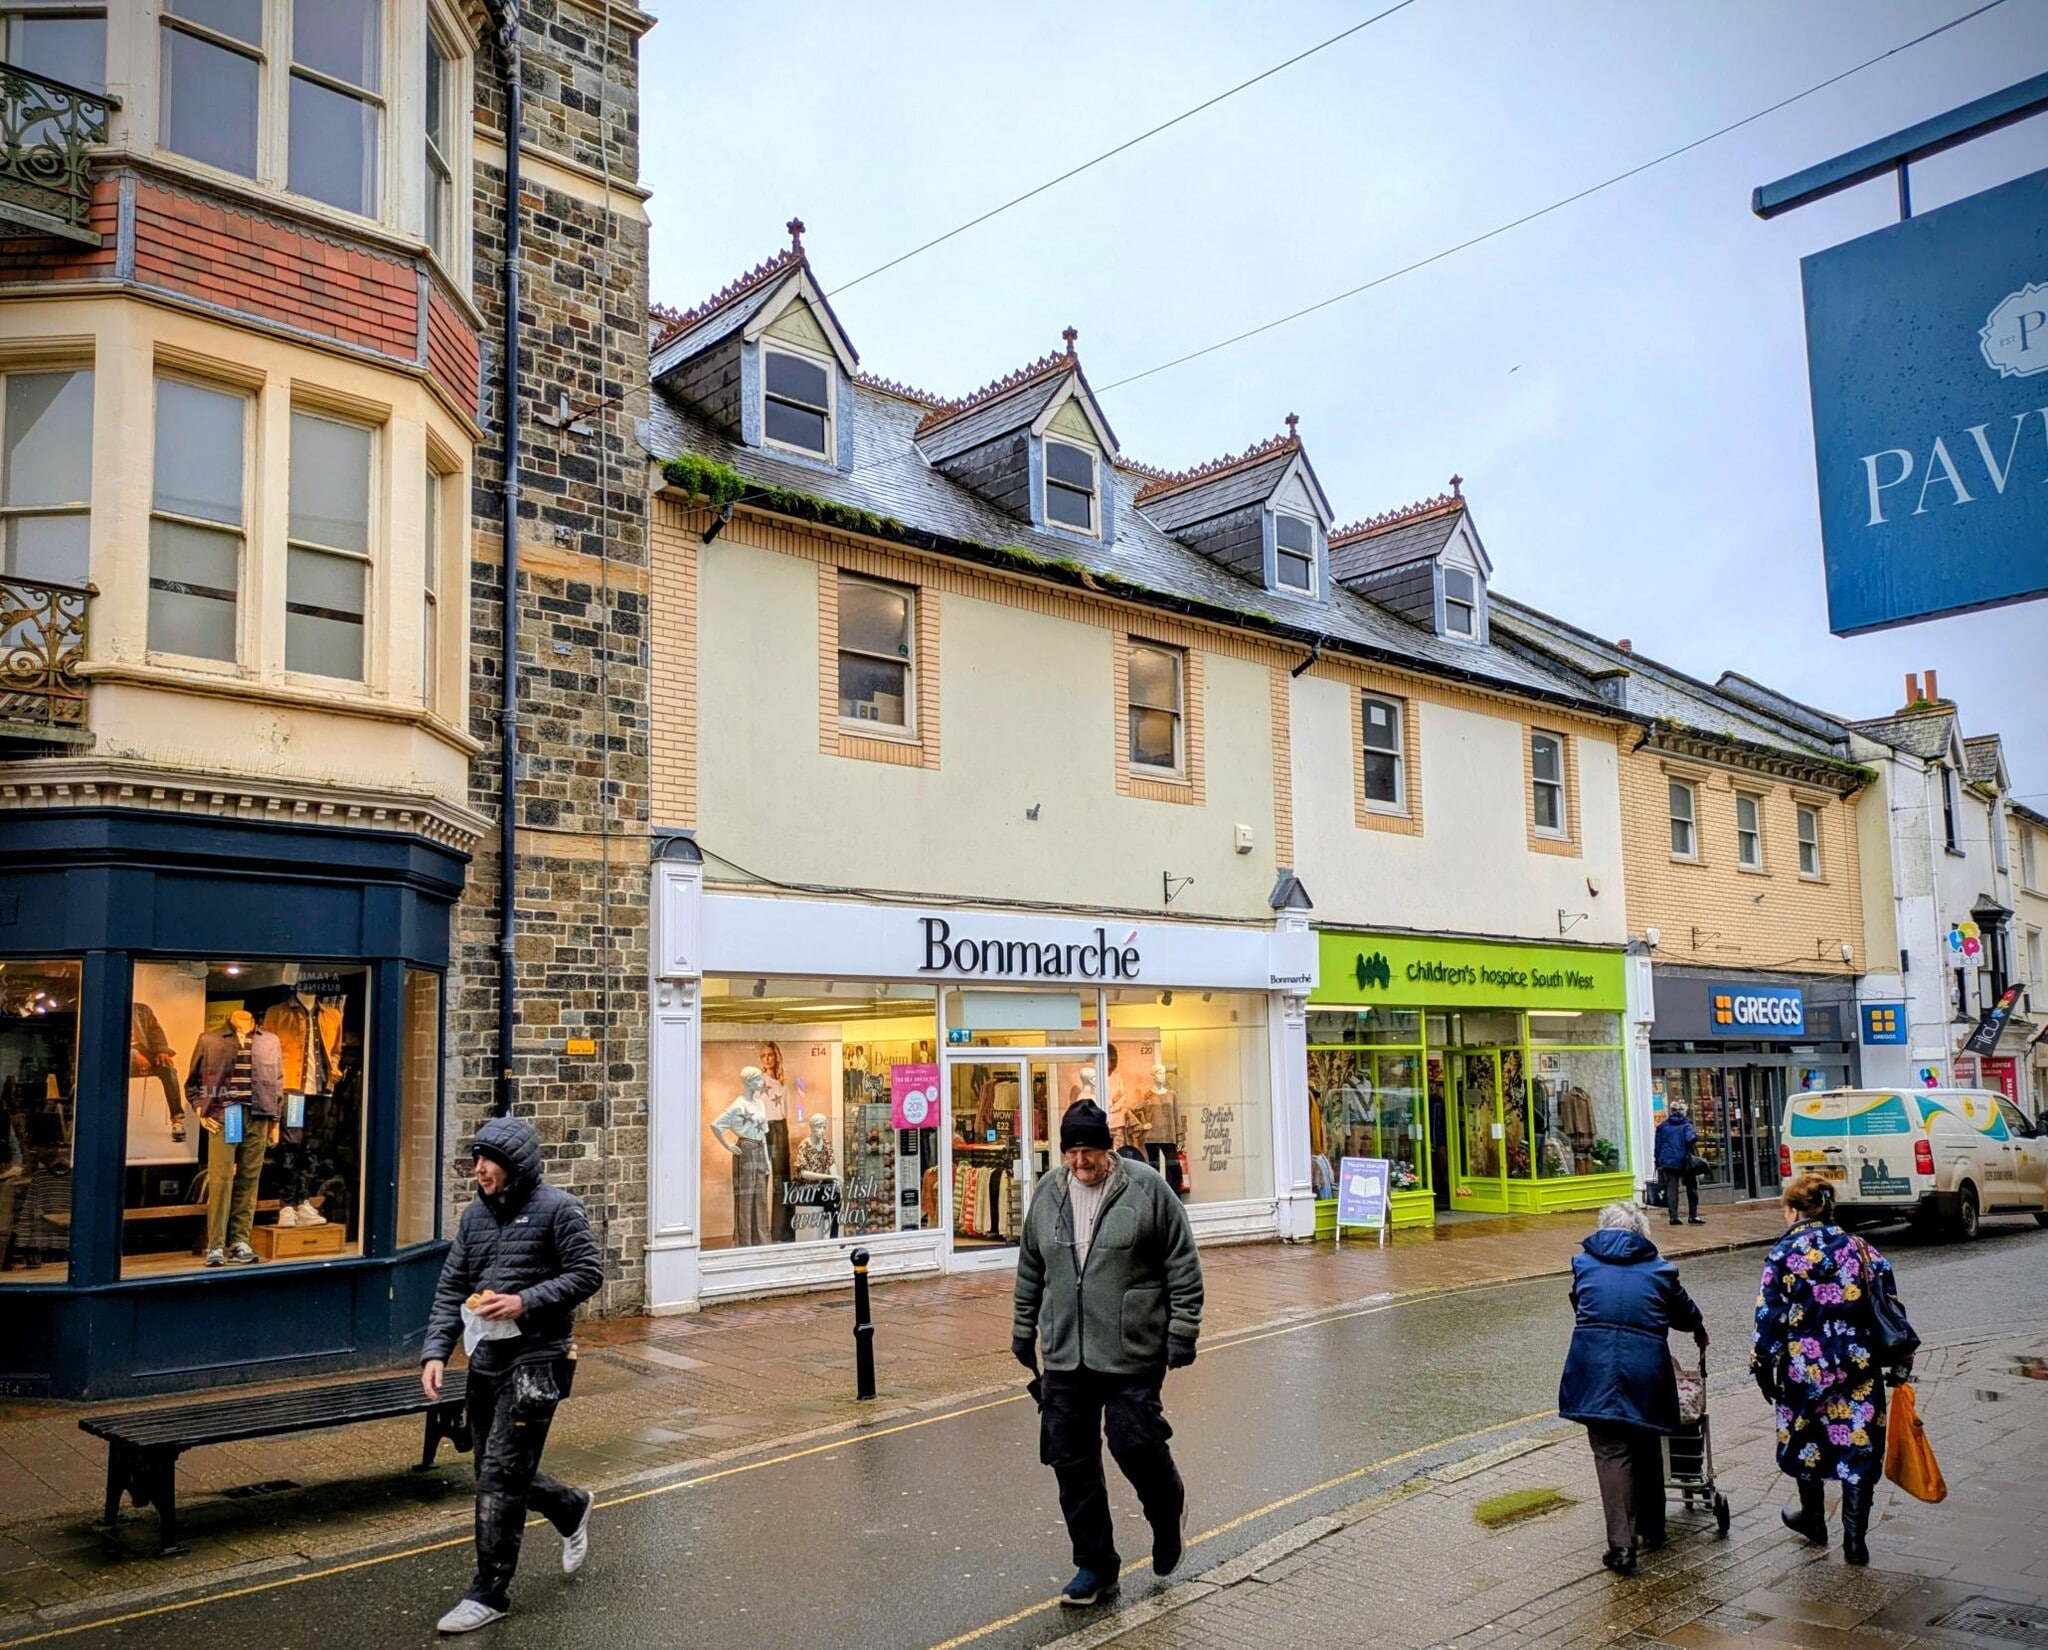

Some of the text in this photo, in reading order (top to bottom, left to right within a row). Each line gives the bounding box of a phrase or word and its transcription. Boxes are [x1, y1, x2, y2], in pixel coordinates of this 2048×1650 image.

[2016, 310, 2046, 352] P
[918, 917, 1140, 978] Bonmarché
[1270, 973, 1312, 984] Bonmarché
[1481, 964, 1528, 989] hospice
[1531, 968, 1564, 988] South
[1565, 969, 1595, 989] West
[1734, 995, 1801, 1025] GREGGS
[811, 1047, 826, 1057] £14
[874, 1050, 908, 1067] Denim
[1140, 1046, 1152, 1055] £20
[997, 1122, 1009, 1130] £22
[1201, 1107, 1234, 1128] Stylish
[1204, 1123, 1230, 1139] looks
[1202, 1138, 1231, 1160] you'll
[1209, 1155, 1227, 1171] love
[782, 1176, 878, 1208] Your stylish
[790, 1202, 871, 1233] everyday
